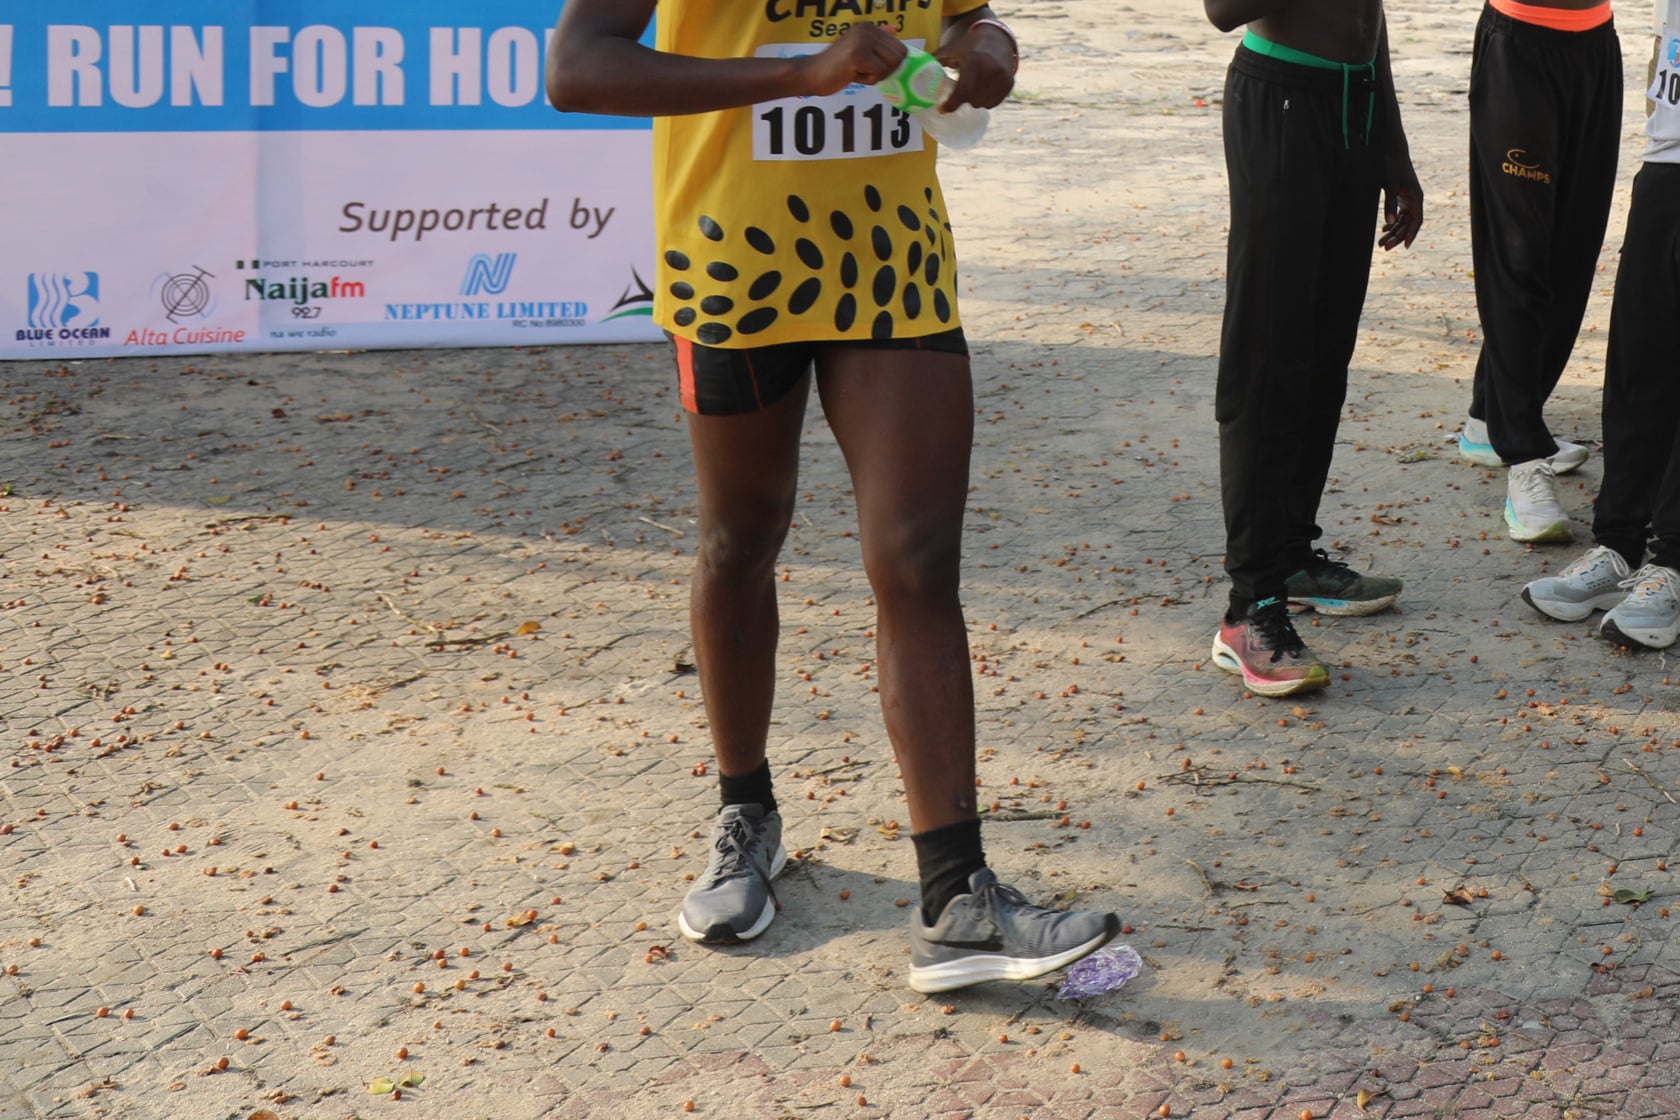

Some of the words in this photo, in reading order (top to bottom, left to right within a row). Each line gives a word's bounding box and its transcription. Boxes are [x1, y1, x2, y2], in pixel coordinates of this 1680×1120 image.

[47, 24, 223, 108] RUN
[249, 24, 405, 108] FOR
[429, 26, 556, 108] HO
[761, 103, 910, 156] 10113
[1502, 162, 1551, 184] CHAMPS
[339, 198, 549, 241] Supported
[569, 197, 615, 239] by
[263, 260, 297, 268] PORT
[302, 260, 374, 268] HARCOURT
[384, 303, 490, 321] NEPTUNE
[497, 301, 588, 319] LIMITED
[16, 329, 53, 341] BLUE
[59, 327, 110, 340] OCEAN
[124, 329, 167, 347] Alta
[172, 327, 246, 345] Cuisine
